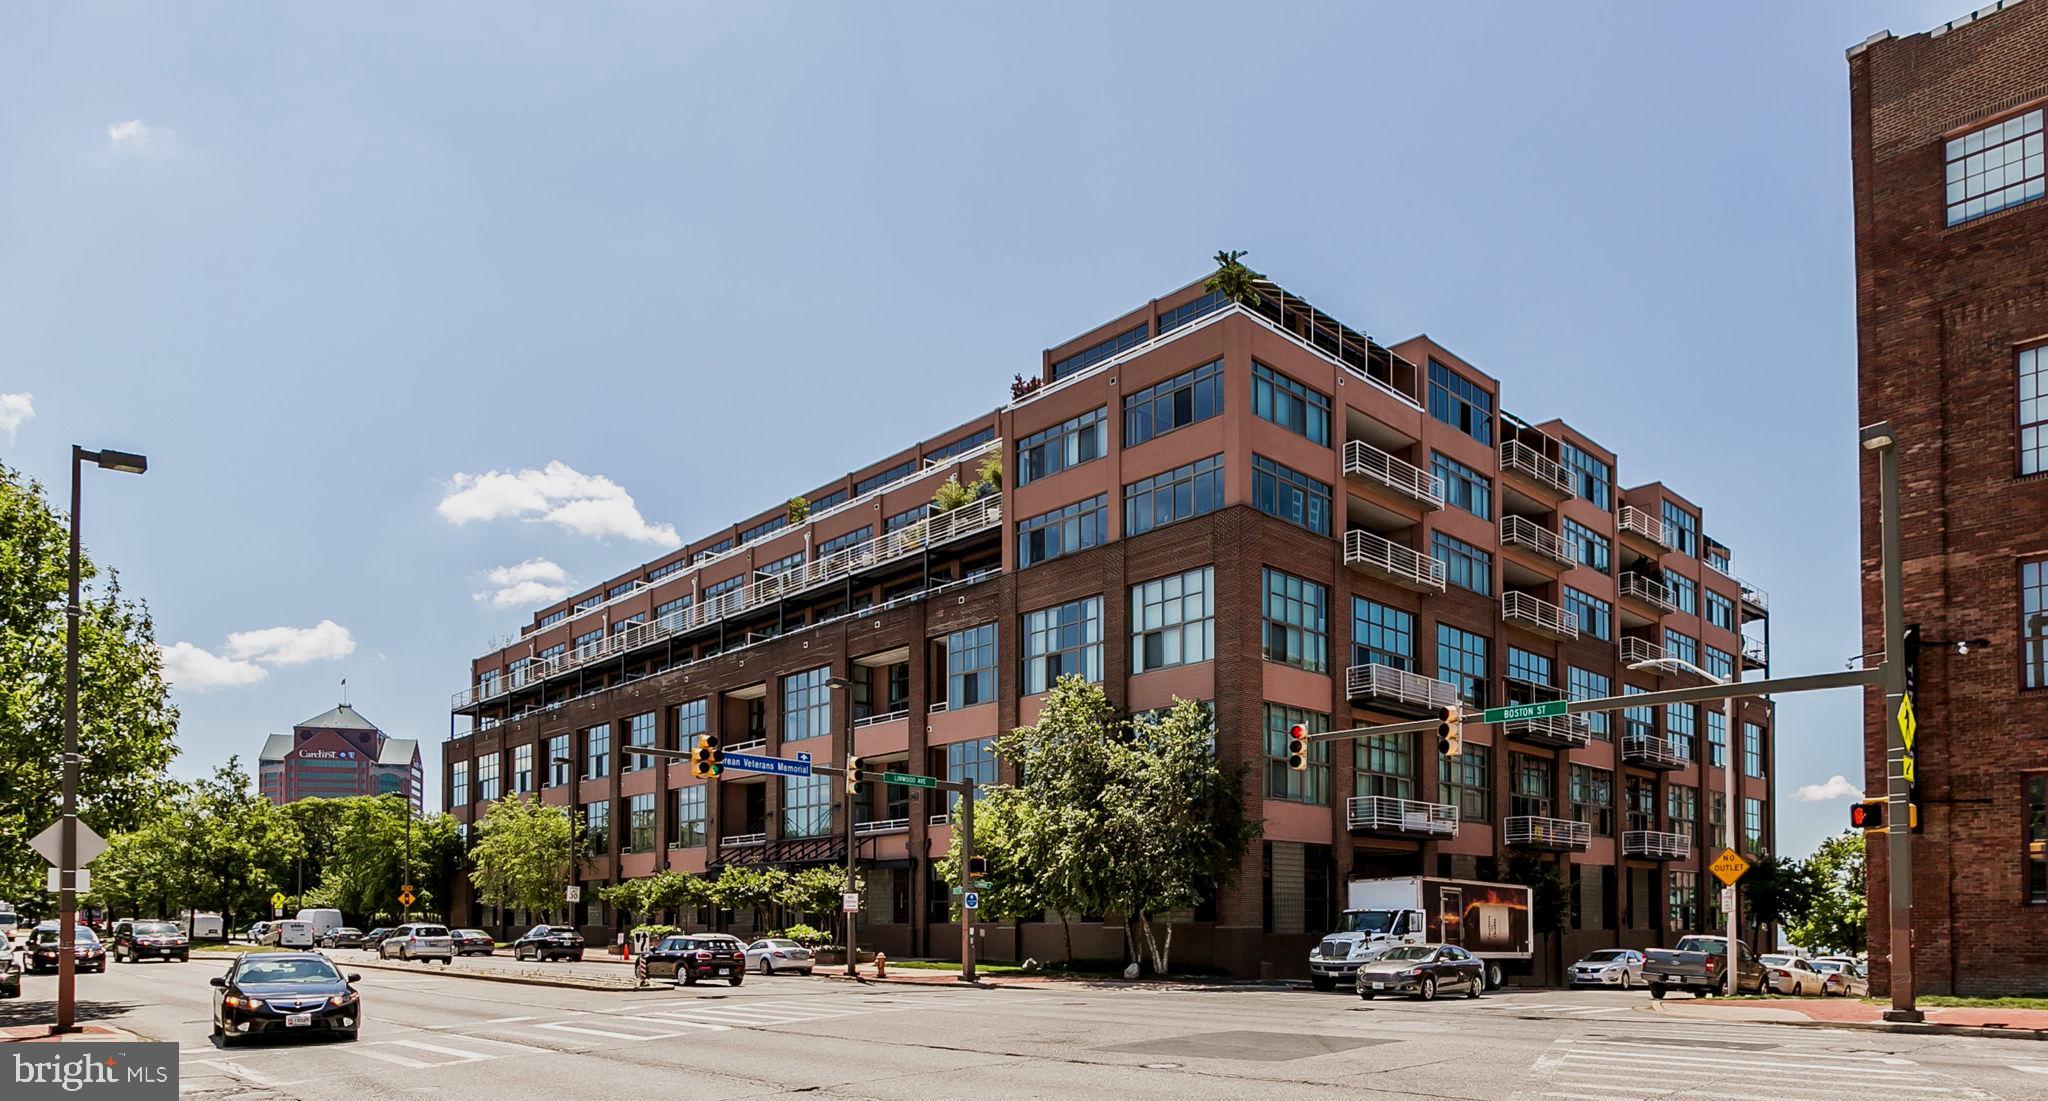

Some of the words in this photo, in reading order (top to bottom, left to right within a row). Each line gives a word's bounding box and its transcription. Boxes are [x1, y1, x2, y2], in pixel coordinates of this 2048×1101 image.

[1504, 707, 1533, 719] BOSTON
[1537, 705, 1546, 715] ST
[743, 758, 775, 771] Veterans
[778, 762, 809, 774] Memorial
[893, 775, 916, 784] LINWOOD
[1714, 864, 1744, 872] OUTLET
